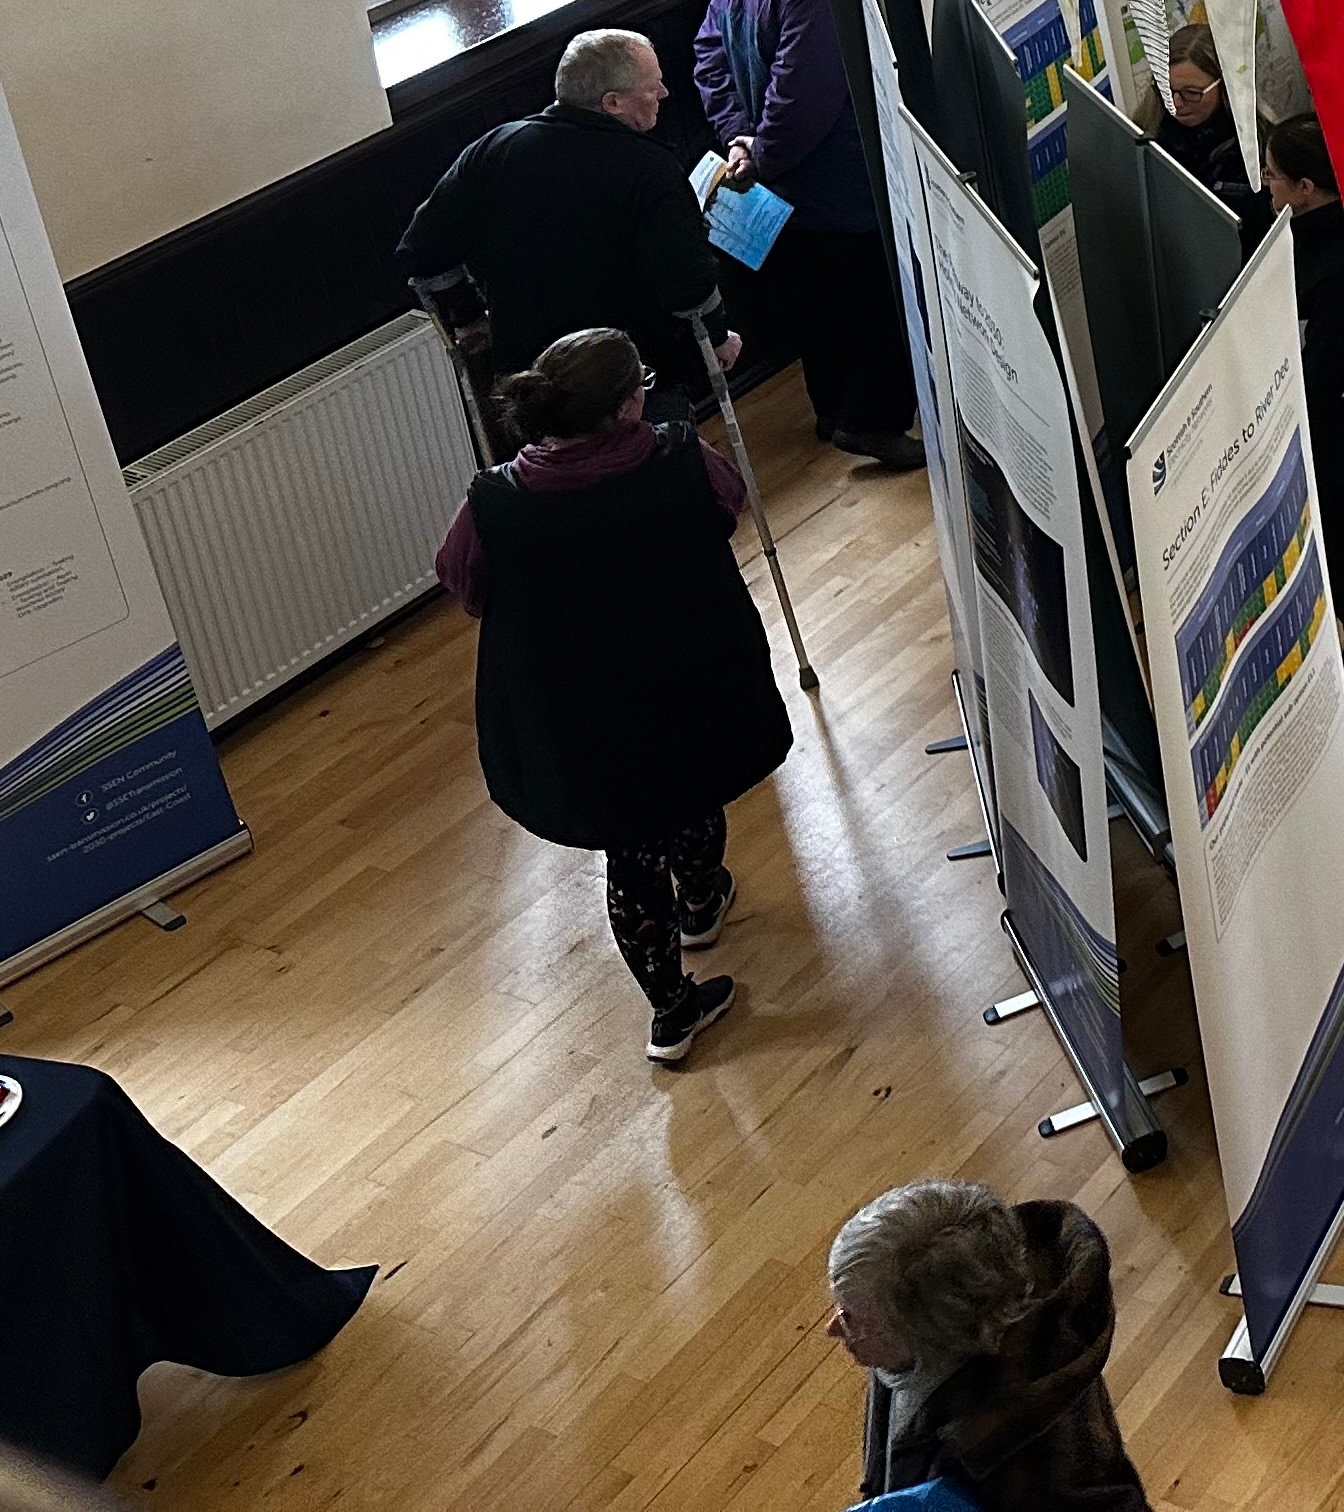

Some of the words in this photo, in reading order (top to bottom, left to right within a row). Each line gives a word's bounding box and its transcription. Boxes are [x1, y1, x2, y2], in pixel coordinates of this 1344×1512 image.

[1167, 423, 1187, 458] Scottish
[1191, 383, 1213, 420] Southern
[1162, 505, 1200, 571] Section
[1210, 438, 1240, 493] Fiddes
[1242, 422, 1255, 443] to
[1255, 384, 1274, 426] River
[1274, 357, 1289, 391] Dee
[102, 774, 125, 792] SSEN
[128, 750, 178, 781] Community
